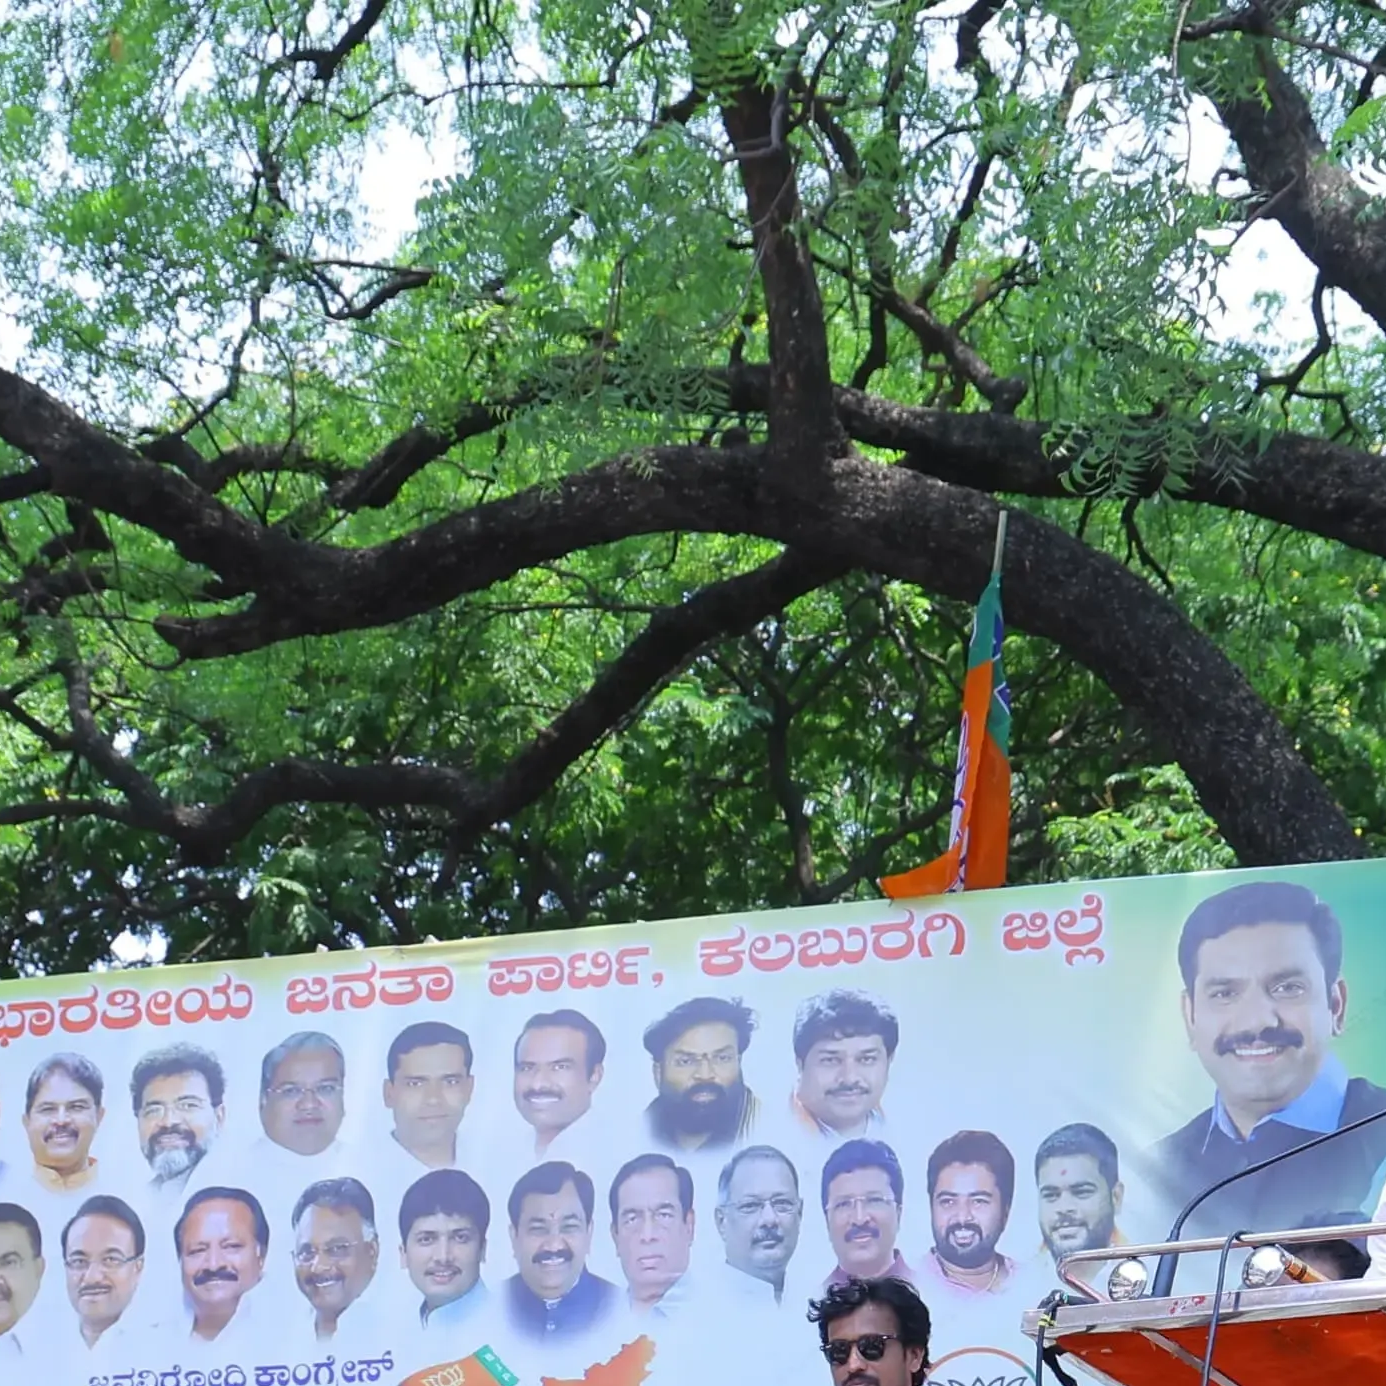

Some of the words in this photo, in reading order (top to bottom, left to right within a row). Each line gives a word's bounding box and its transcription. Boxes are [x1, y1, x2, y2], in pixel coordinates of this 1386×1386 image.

[287, 960, 454, 1014] ಜನತಾ
[699, 908, 966, 976] ಕಲಬುರಗಿ
[1002, 894, 1105, 966] ಜಿಲ್ಲೆ
